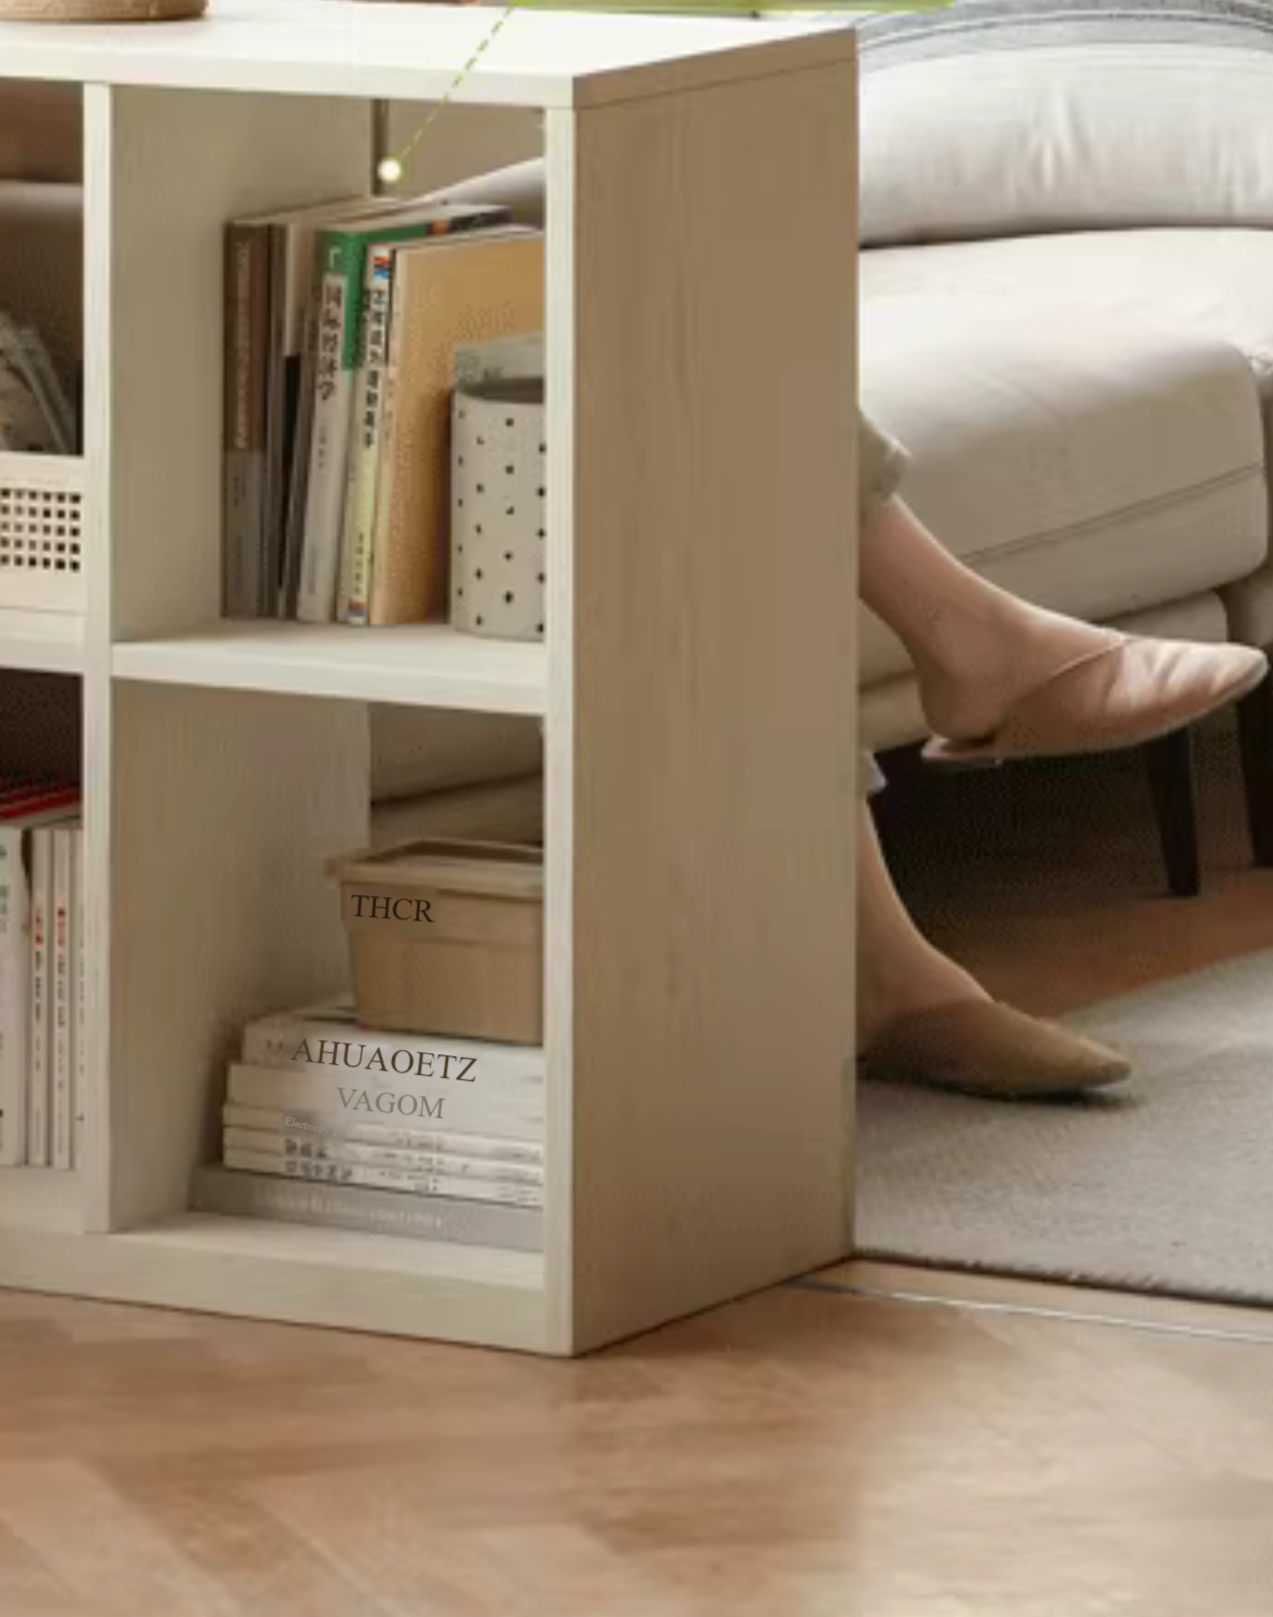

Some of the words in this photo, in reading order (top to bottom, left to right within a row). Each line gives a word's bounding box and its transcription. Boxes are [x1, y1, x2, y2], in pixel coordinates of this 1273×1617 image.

[350, 893, 434, 924] THCR
[290, 1038, 478, 1083] AHUAOETZ
[336, 1086, 446, 1119] VAGOM
